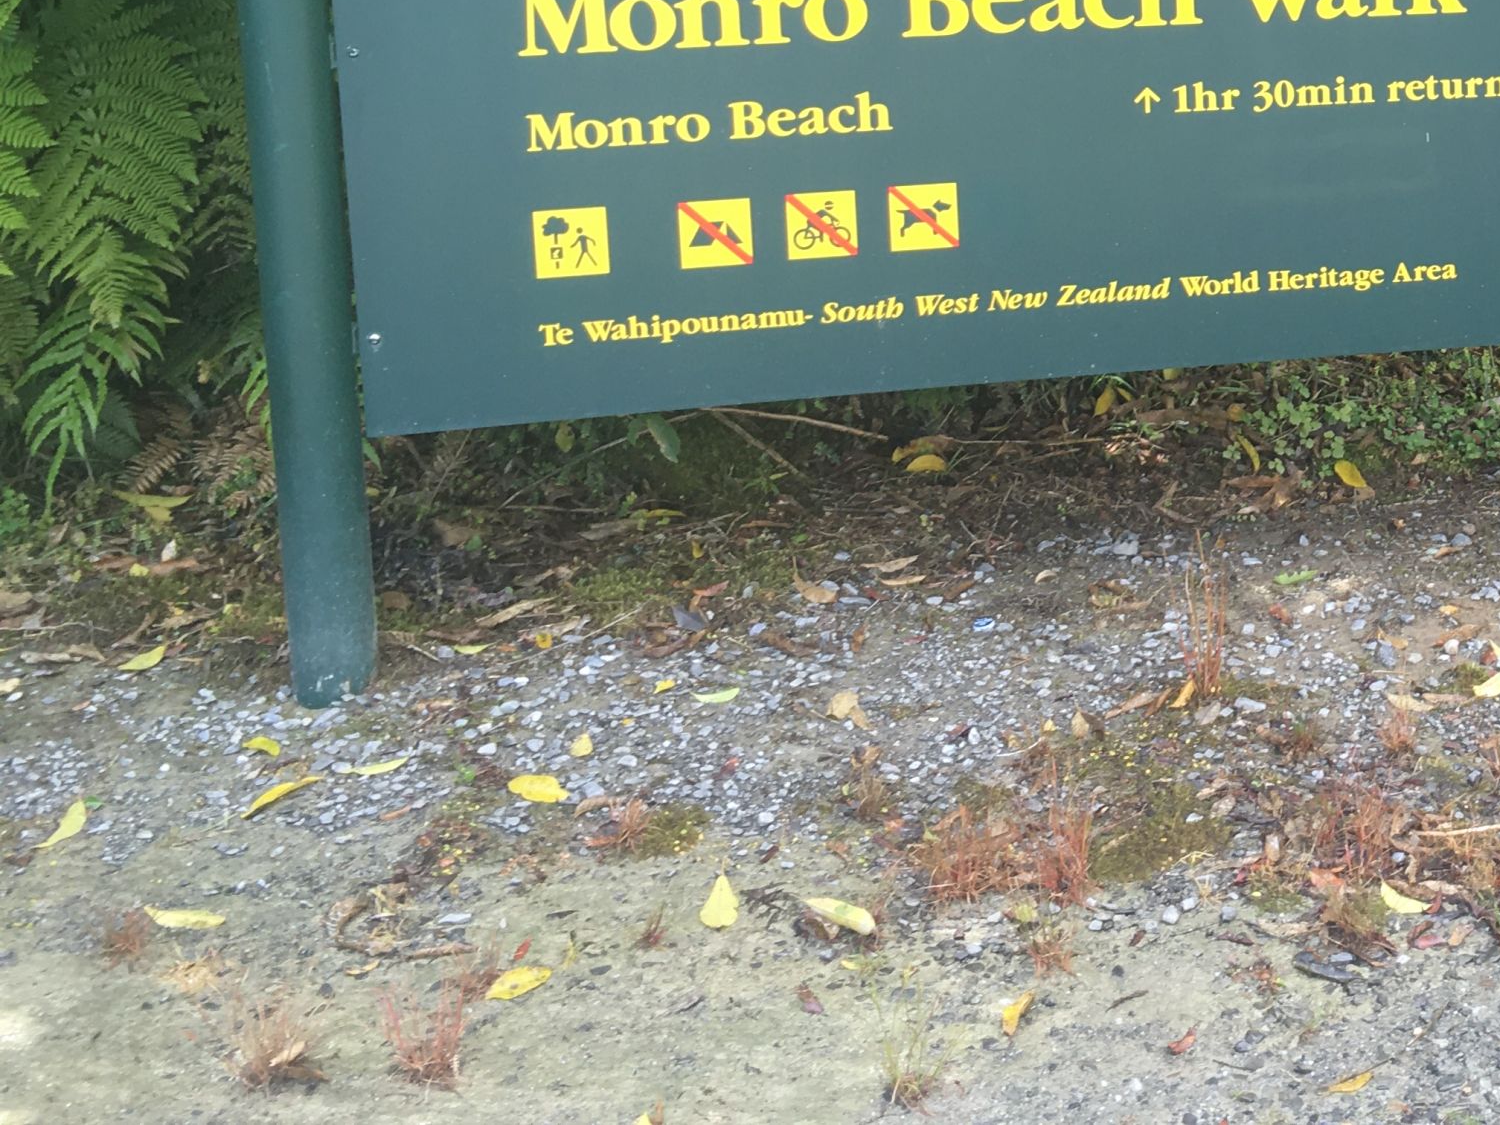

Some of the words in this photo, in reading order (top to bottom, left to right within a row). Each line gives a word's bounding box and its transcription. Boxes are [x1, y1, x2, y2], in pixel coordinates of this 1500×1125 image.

[525, 111, 711, 153] Monro
[727, 90, 894, 140] Beach
[1172, 81, 1241, 113] 1hr
[1252, 75, 1376, 113] 30min
[538, 322, 574, 347] Te
[820, 296, 904, 324] South
[915, 293, 980, 317] West
[987, 289, 1048, 312] New
[1056, 276, 1171, 307] Zealand
[1179, 270, 1261, 297] World
[1267, 266, 1385, 292] Heritage
[1392, 262, 1458, 283] Area
